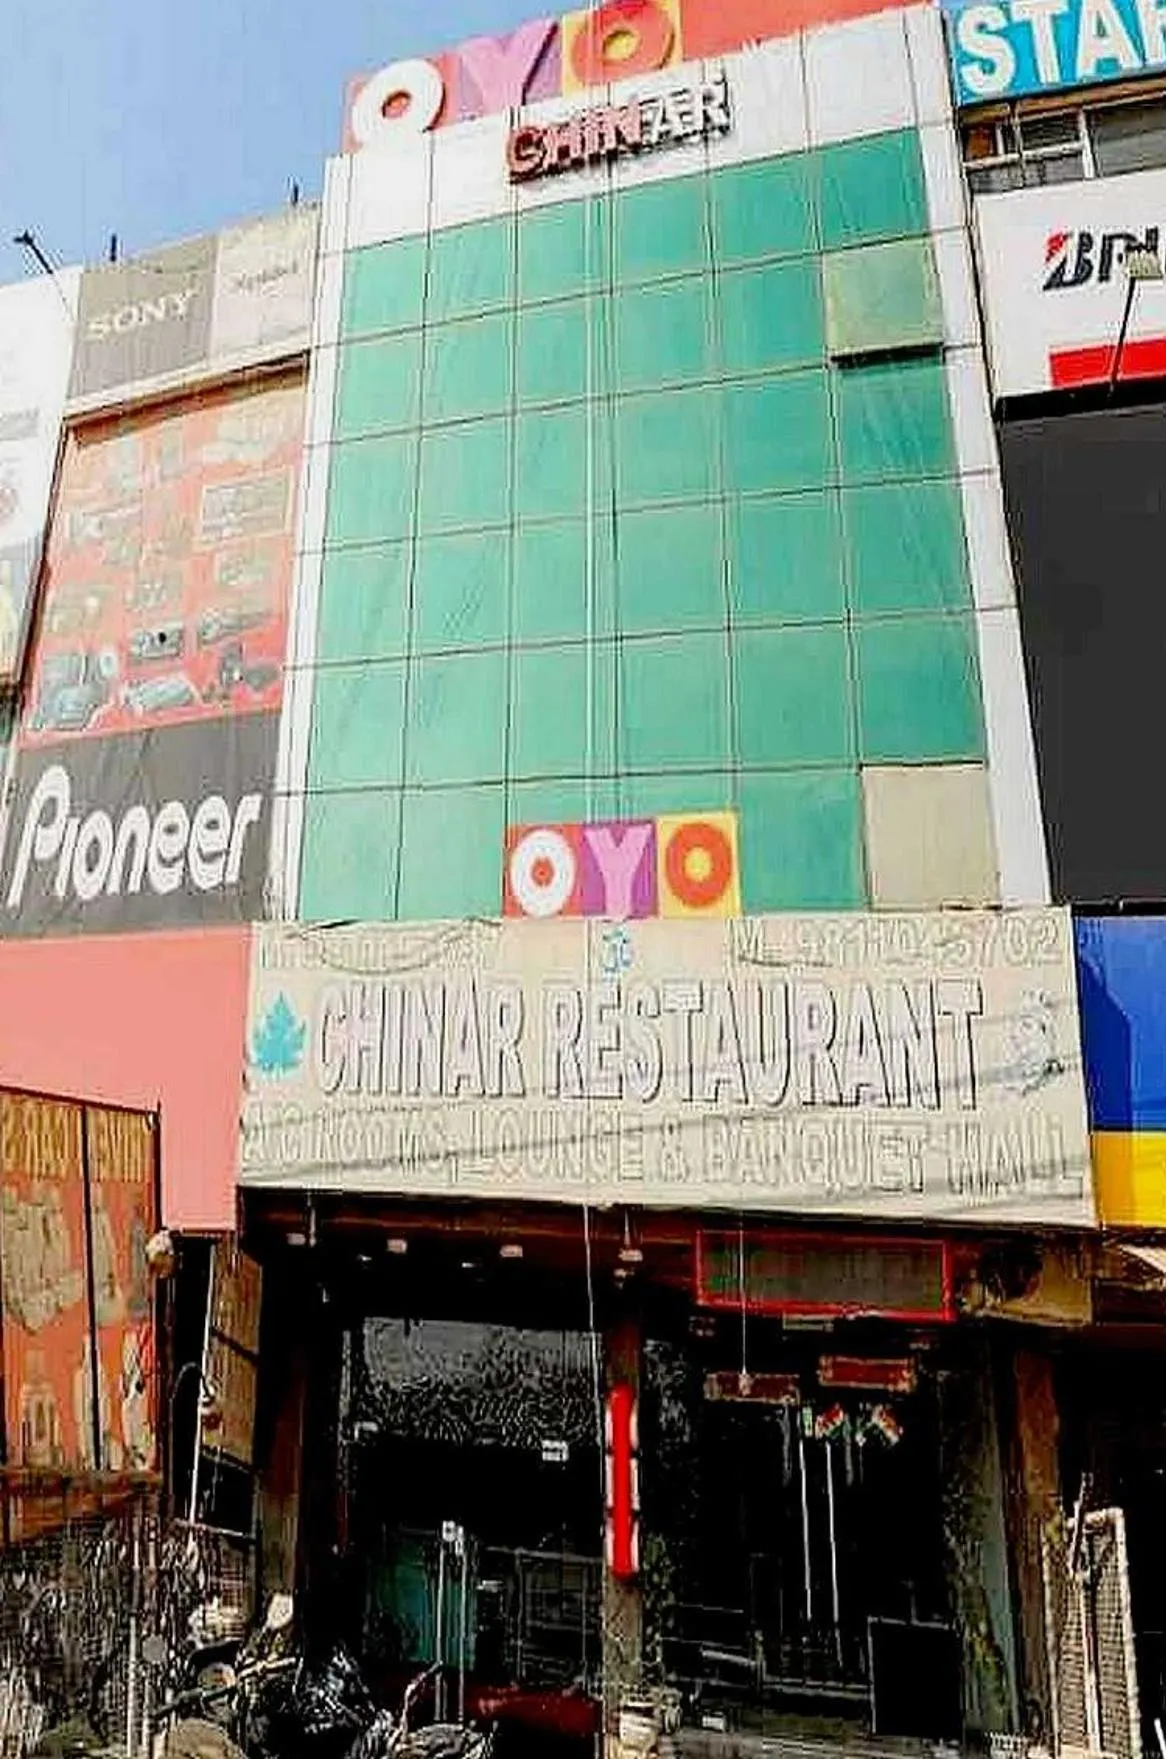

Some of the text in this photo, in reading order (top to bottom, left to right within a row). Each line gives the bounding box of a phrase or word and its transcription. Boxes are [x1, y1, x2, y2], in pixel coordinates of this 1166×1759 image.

[352, 0, 675, 143] OYO
[87, 284, 202, 341] SONY
[8, 765, 262, 908] Pioneer
[509, 820, 734, 919] OYO
[320, 977, 984, 1111] CHINAR RESTAURANT
[466, 1104, 646, 1182] LOUNGE
[703, 1115, 924, 1194] BANQUET
[946, 1110, 1083, 1198] HALL
